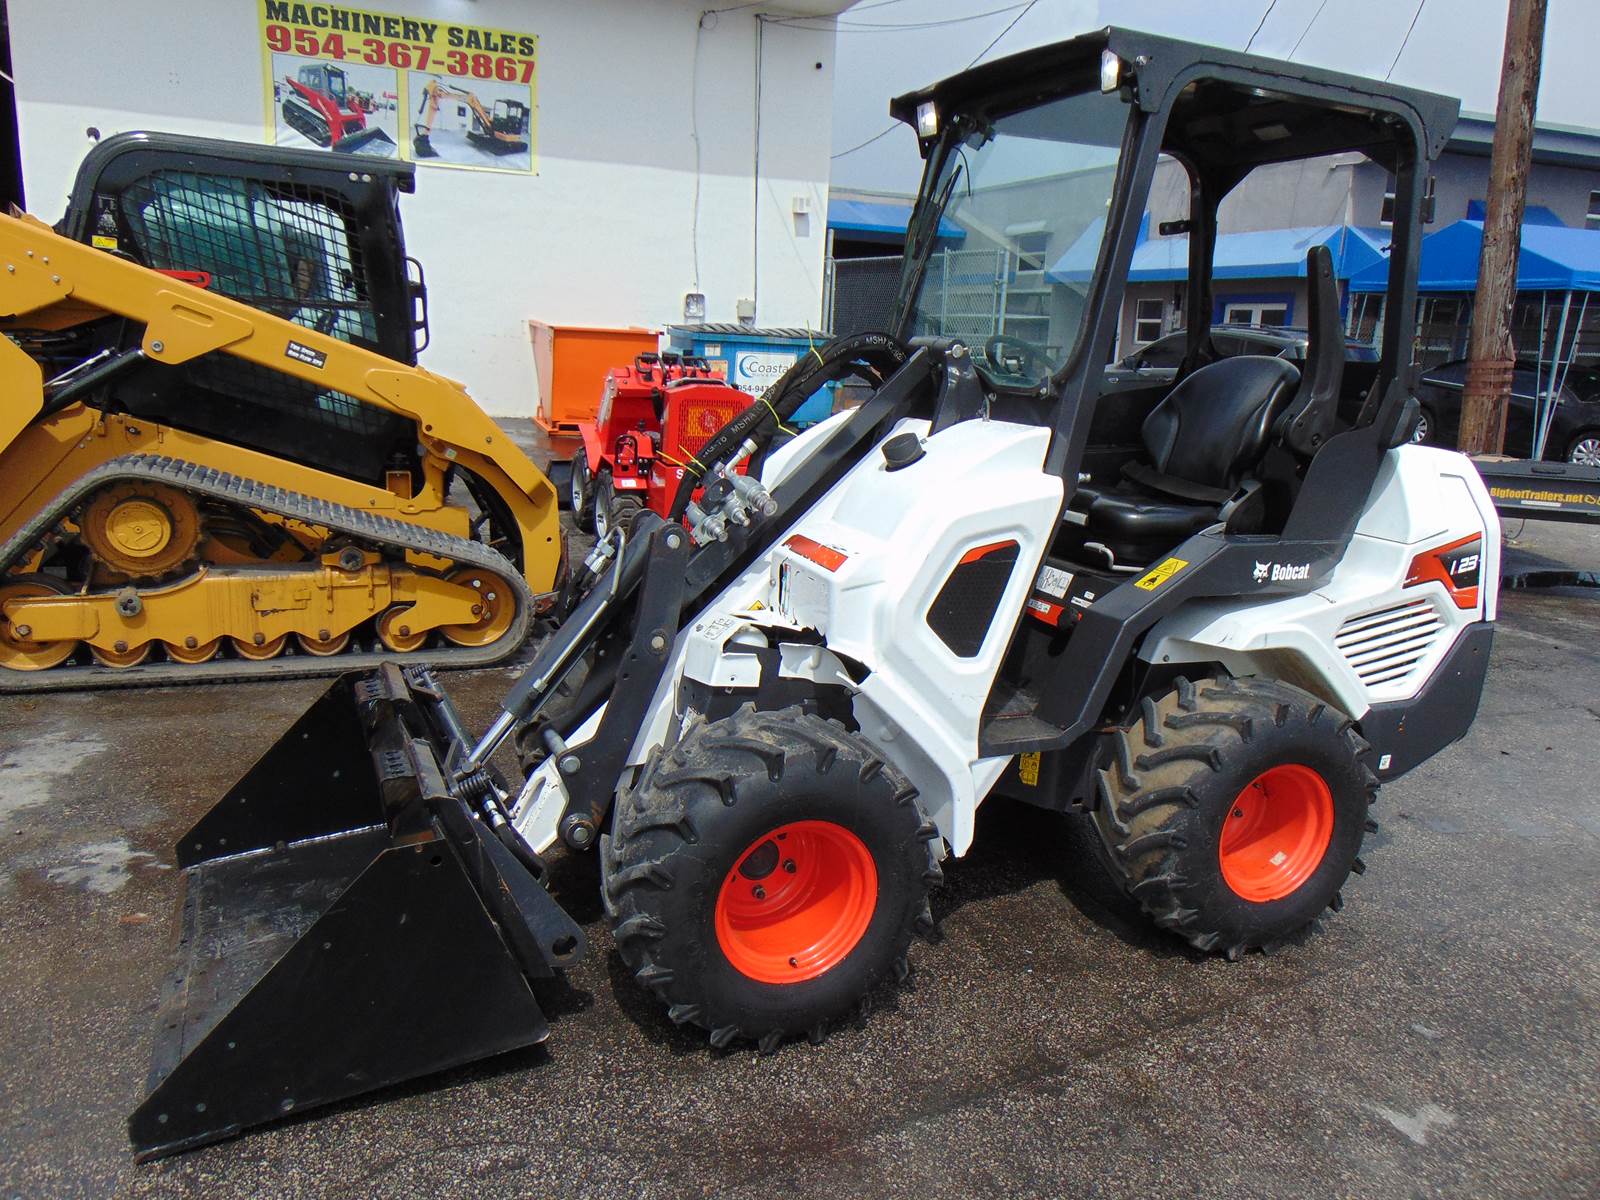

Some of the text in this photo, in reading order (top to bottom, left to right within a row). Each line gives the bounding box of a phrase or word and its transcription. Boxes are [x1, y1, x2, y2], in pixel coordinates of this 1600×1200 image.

[265, 0, 535, 57] MACHINERY SALES
[266, 24, 536, 84] 954-367-3867
[1490, 487, 1583, 504] BigfootTrailers.net
[1271, 563, 1310, 581] Bobcat
